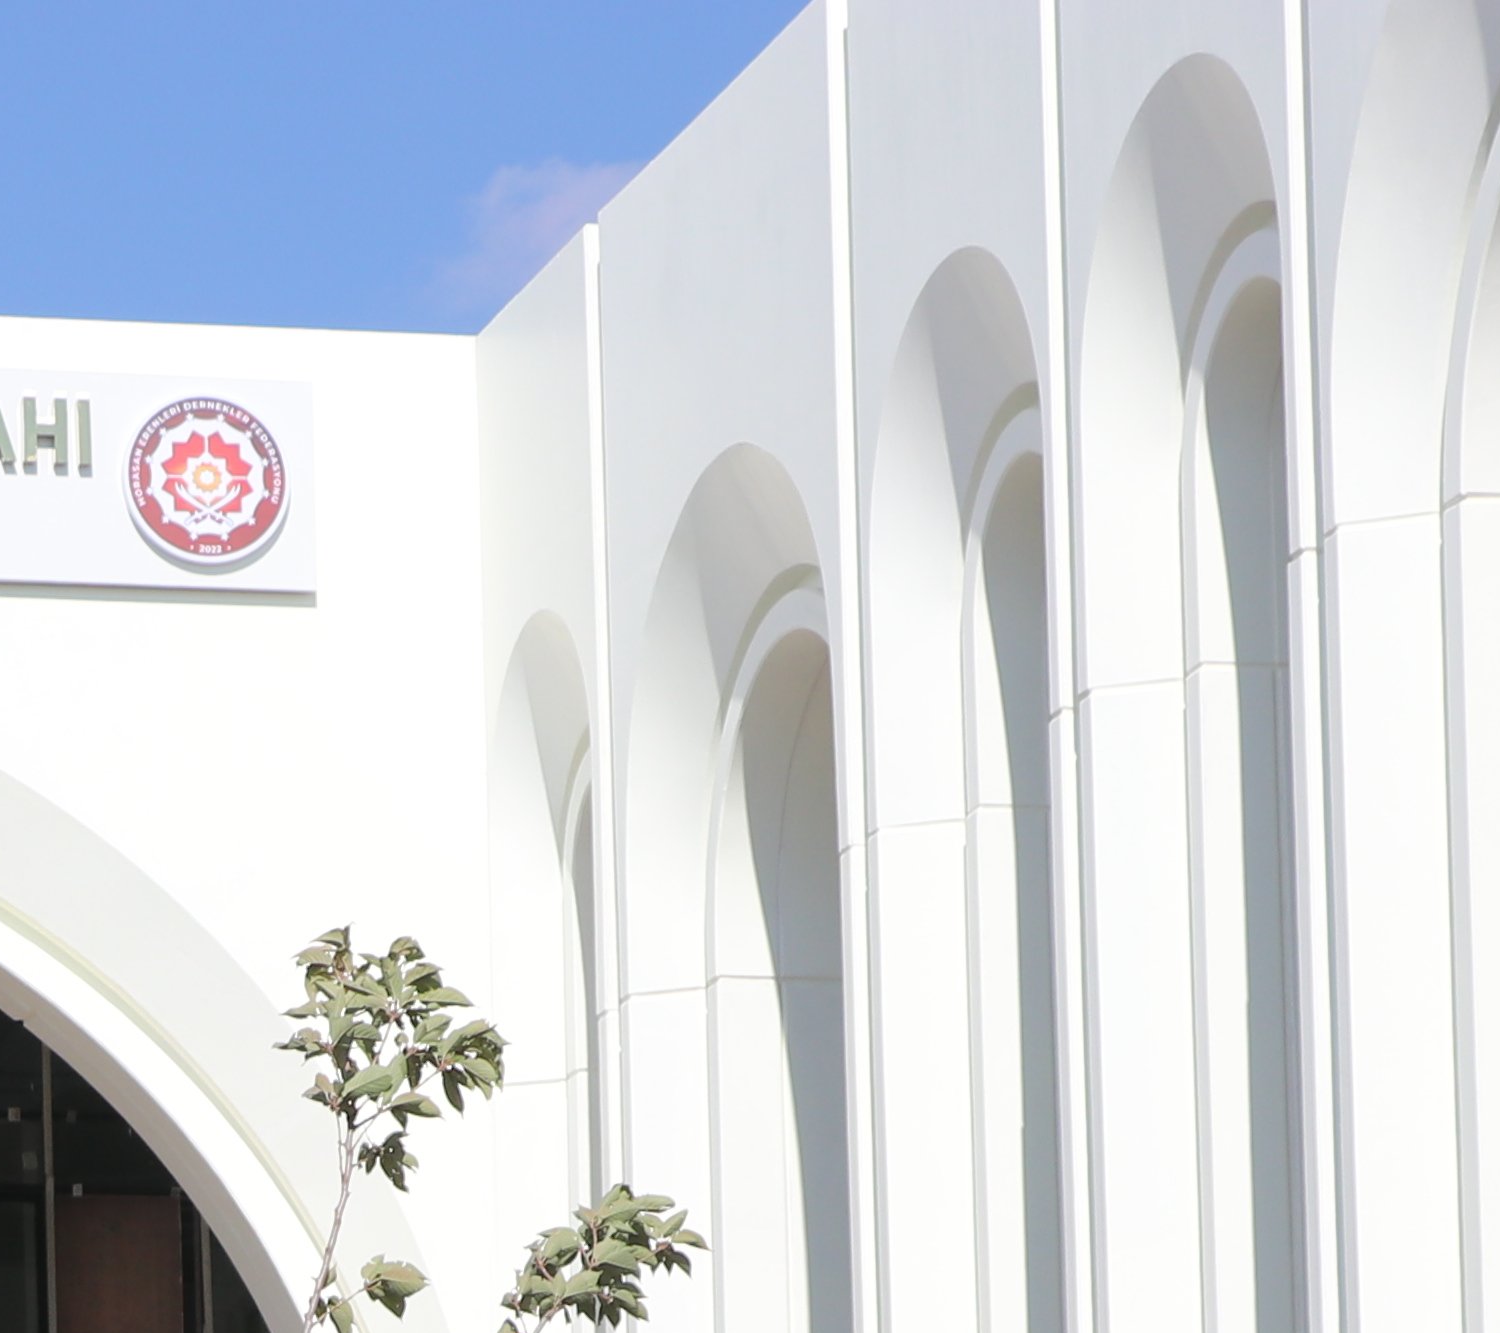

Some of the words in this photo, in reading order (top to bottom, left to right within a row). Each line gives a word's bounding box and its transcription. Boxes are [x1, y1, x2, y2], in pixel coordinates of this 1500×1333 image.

[130, 447, 147, 508] HORASAN
[140, 404, 182, 443] ERENLERİ
[182, 400, 251, 423] DERNEKLER
[250, 421, 282, 505] FEDERASYONU
